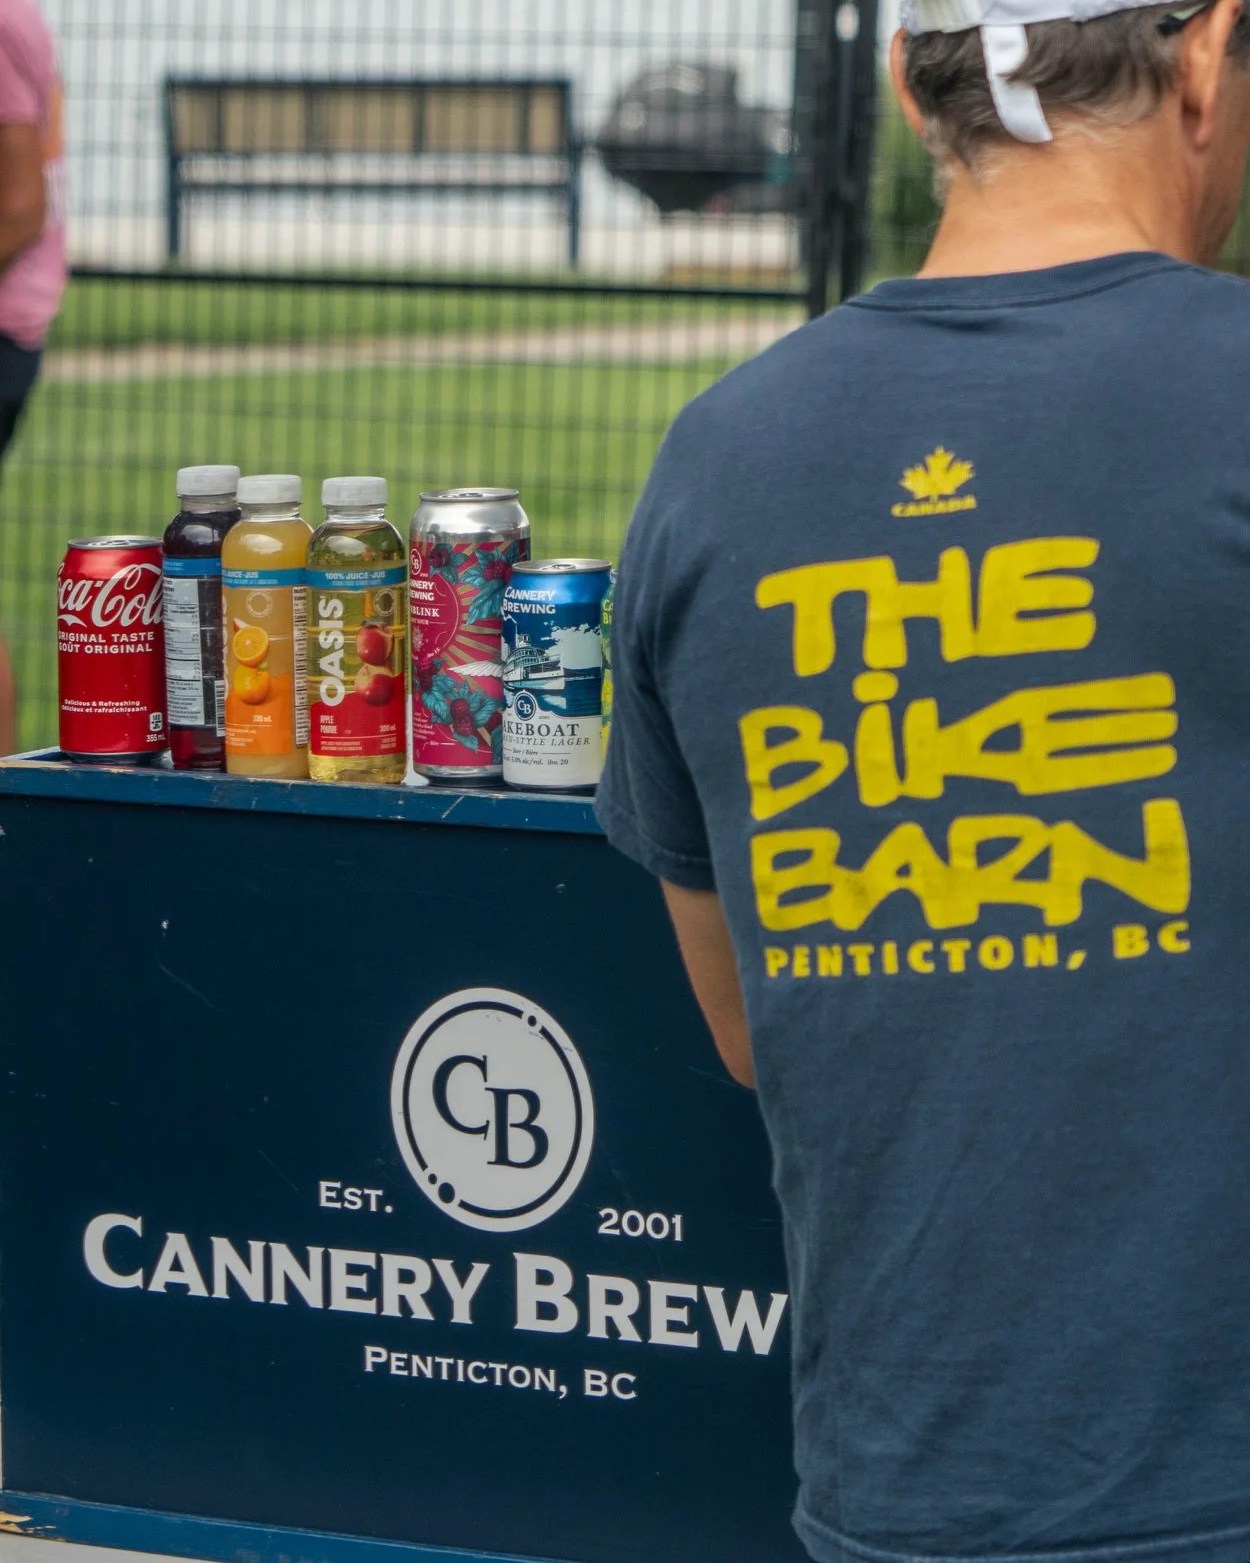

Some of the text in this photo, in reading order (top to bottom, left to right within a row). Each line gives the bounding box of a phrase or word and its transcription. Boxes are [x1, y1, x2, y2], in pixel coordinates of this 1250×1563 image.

[503, 598, 556, 615] BREWING
[504, 586, 556, 602] CANNERY
[755, 535, 1099, 677] THE
[84, 643, 153, 654] ORIGINAL
[112, 632, 154, 643] TASTE
[318, 596, 345, 707] OASIS
[517, 700, 532, 715] CB
[551, 737, 591, 746] LAGER
[749, 797, 1191, 932] BARN
[764, 921, 1191, 978] PENTICTON, BC
[432, 1054, 549, 1169] CB
[598, 1207, 684, 1242] 2001
[82, 1213, 490, 1325] CANNERY
[364, 1345, 638, 1400] PENTICTON, BC
